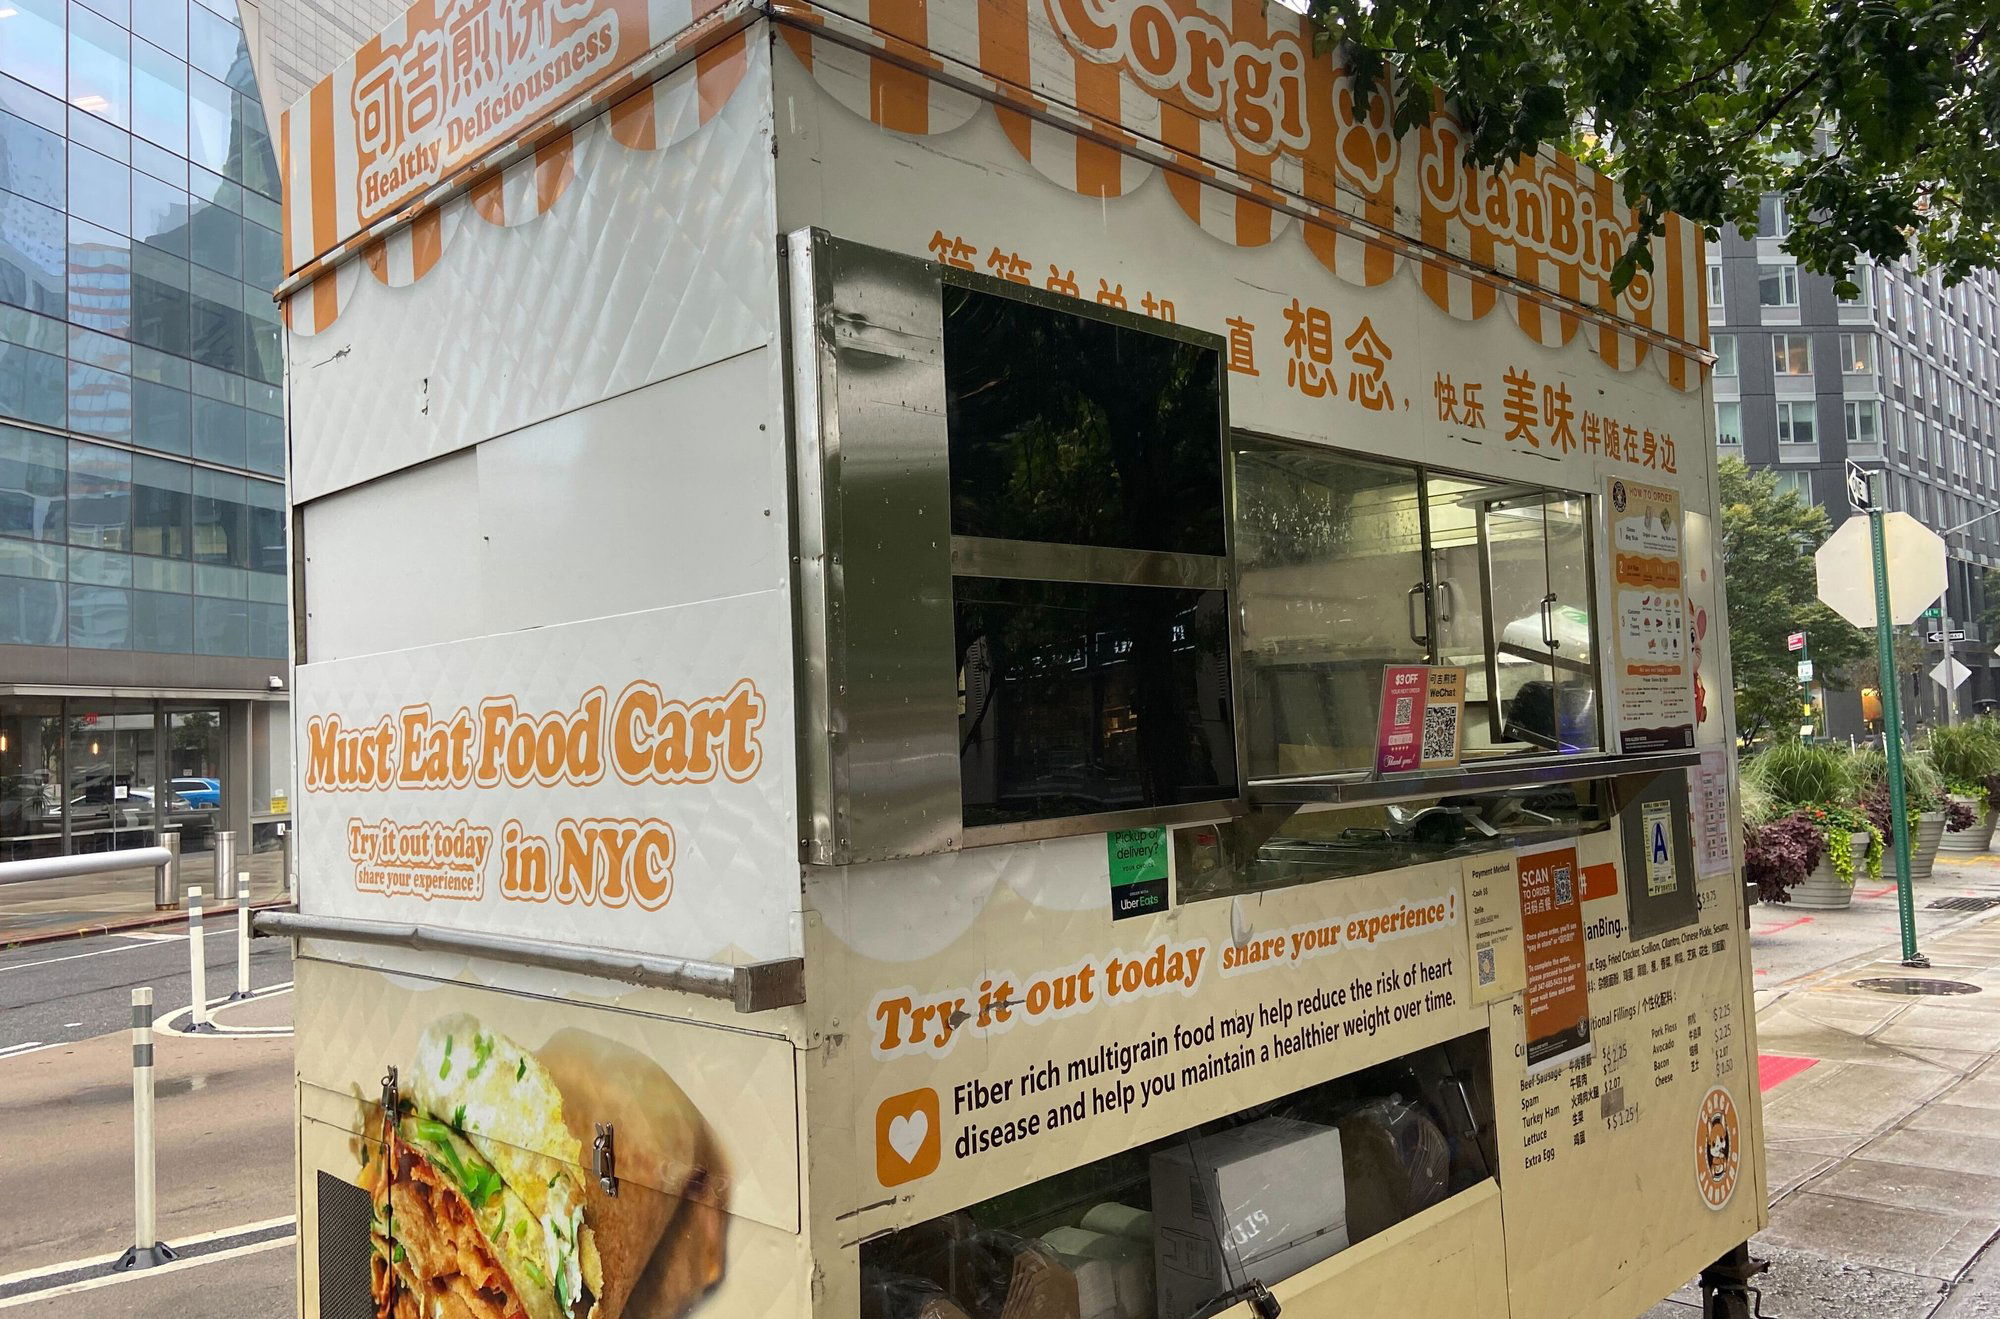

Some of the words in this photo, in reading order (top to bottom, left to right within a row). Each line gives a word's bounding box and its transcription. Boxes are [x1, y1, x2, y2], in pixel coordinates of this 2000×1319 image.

[365, 137, 442, 208] Healthy
[447, 23, 612, 150] Deliciousness
[1430, 688, 1456, 698] WeChat
[308, 720, 393, 786] Must
[399, 708, 472, 783] Eat
[479, 695, 601, 780] Food
[614, 688, 760, 779] Cart
[350, 826, 378, 863] Try
[381, 821, 397, 856] it
[399, 829, 430, 858] out
[434, 822, 489, 865] today
[1115, 830, 1147, 844] Pickup
[1148, 829, 1159, 839] or
[1653, 823, 1668, 863] A
[1116, 842, 1159, 860] delivery?
[504, 828, 549, 893] in
[558, 828, 670, 901] NYC
[1472, 868, 1493, 879] Payment
[1493, 862, 1511, 874] Method
[358, 867, 386, 886] share
[386, 872, 410, 889] your
[413, 873, 474, 893] experience
[1522, 868, 1549, 887] SCAN
[1523, 889, 1531, 899] TO
[1532, 886, 1551, 897] ORDER
[1120, 899, 1140, 911] Uber
[1140, 895, 1159, 907] Eats
[1291, 925, 1341, 960] your
[1346, 903, 1445, 943] experience
[1608, 950, 1621, 965] Fried
[876, 996, 967, 1050] Try
[976, 979, 1015, 1028] it
[1025, 964, 1096, 1017] out
[1105, 944, 1206, 998] today
[1613, 1005, 1636, 1024] Fillings
[954, 1078, 1014, 1116] Fiber
[1020, 1060, 1060, 1096] rich
[1067, 1032, 1168, 1082] multigrain
[1174, 1016, 1215, 1052] food
[1220, 1012, 1255, 1039] may
[1259, 998, 1293, 1028] help
[1297, 987, 1346, 1017] reduce
[1350, 977, 1373, 1003] the
[1376, 969, 1401, 995] risk
[1404, 963, 1418, 988] of
[1420, 957, 1453, 984] heart
[1651, 1026, 1664, 1039] Pork
[1664, 1022, 1677, 1035] Floss
[1652, 1038, 1675, 1055] Avocado
[954, 1112, 1040, 1159] disease
[1046, 1091, 1086, 1130] and
[1092, 1080, 1136, 1115] help
[1141, 1072, 1176, 1108] you
[1181, 1044, 1256, 1087] maintain
[1260, 1043, 1269, 1062] a
[1273, 1021, 1340, 1059] healthier
[1343, 1005, 1392, 1037] weight
[1394, 999, 1422, 1023] over
[1425, 990, 1457, 1014] time.
[1653, 1058, 1670, 1072] Bacon
[1520, 1075, 1535, 1091] Beef
[1535, 1068, 1562, 1086] Sausage
[1655, 1072, 1673, 1088] Cheese
[1521, 1095, 1539, 1112] Spam
[1522, 1111, 1544, 1129] Turkey
[1544, 1105, 1560, 1119] Ham
[1523, 1129, 1547, 1148] Lettuce
[1525, 1153, 1542, 1169] Extra
[1543, 1147, 1555, 1162] Egg
